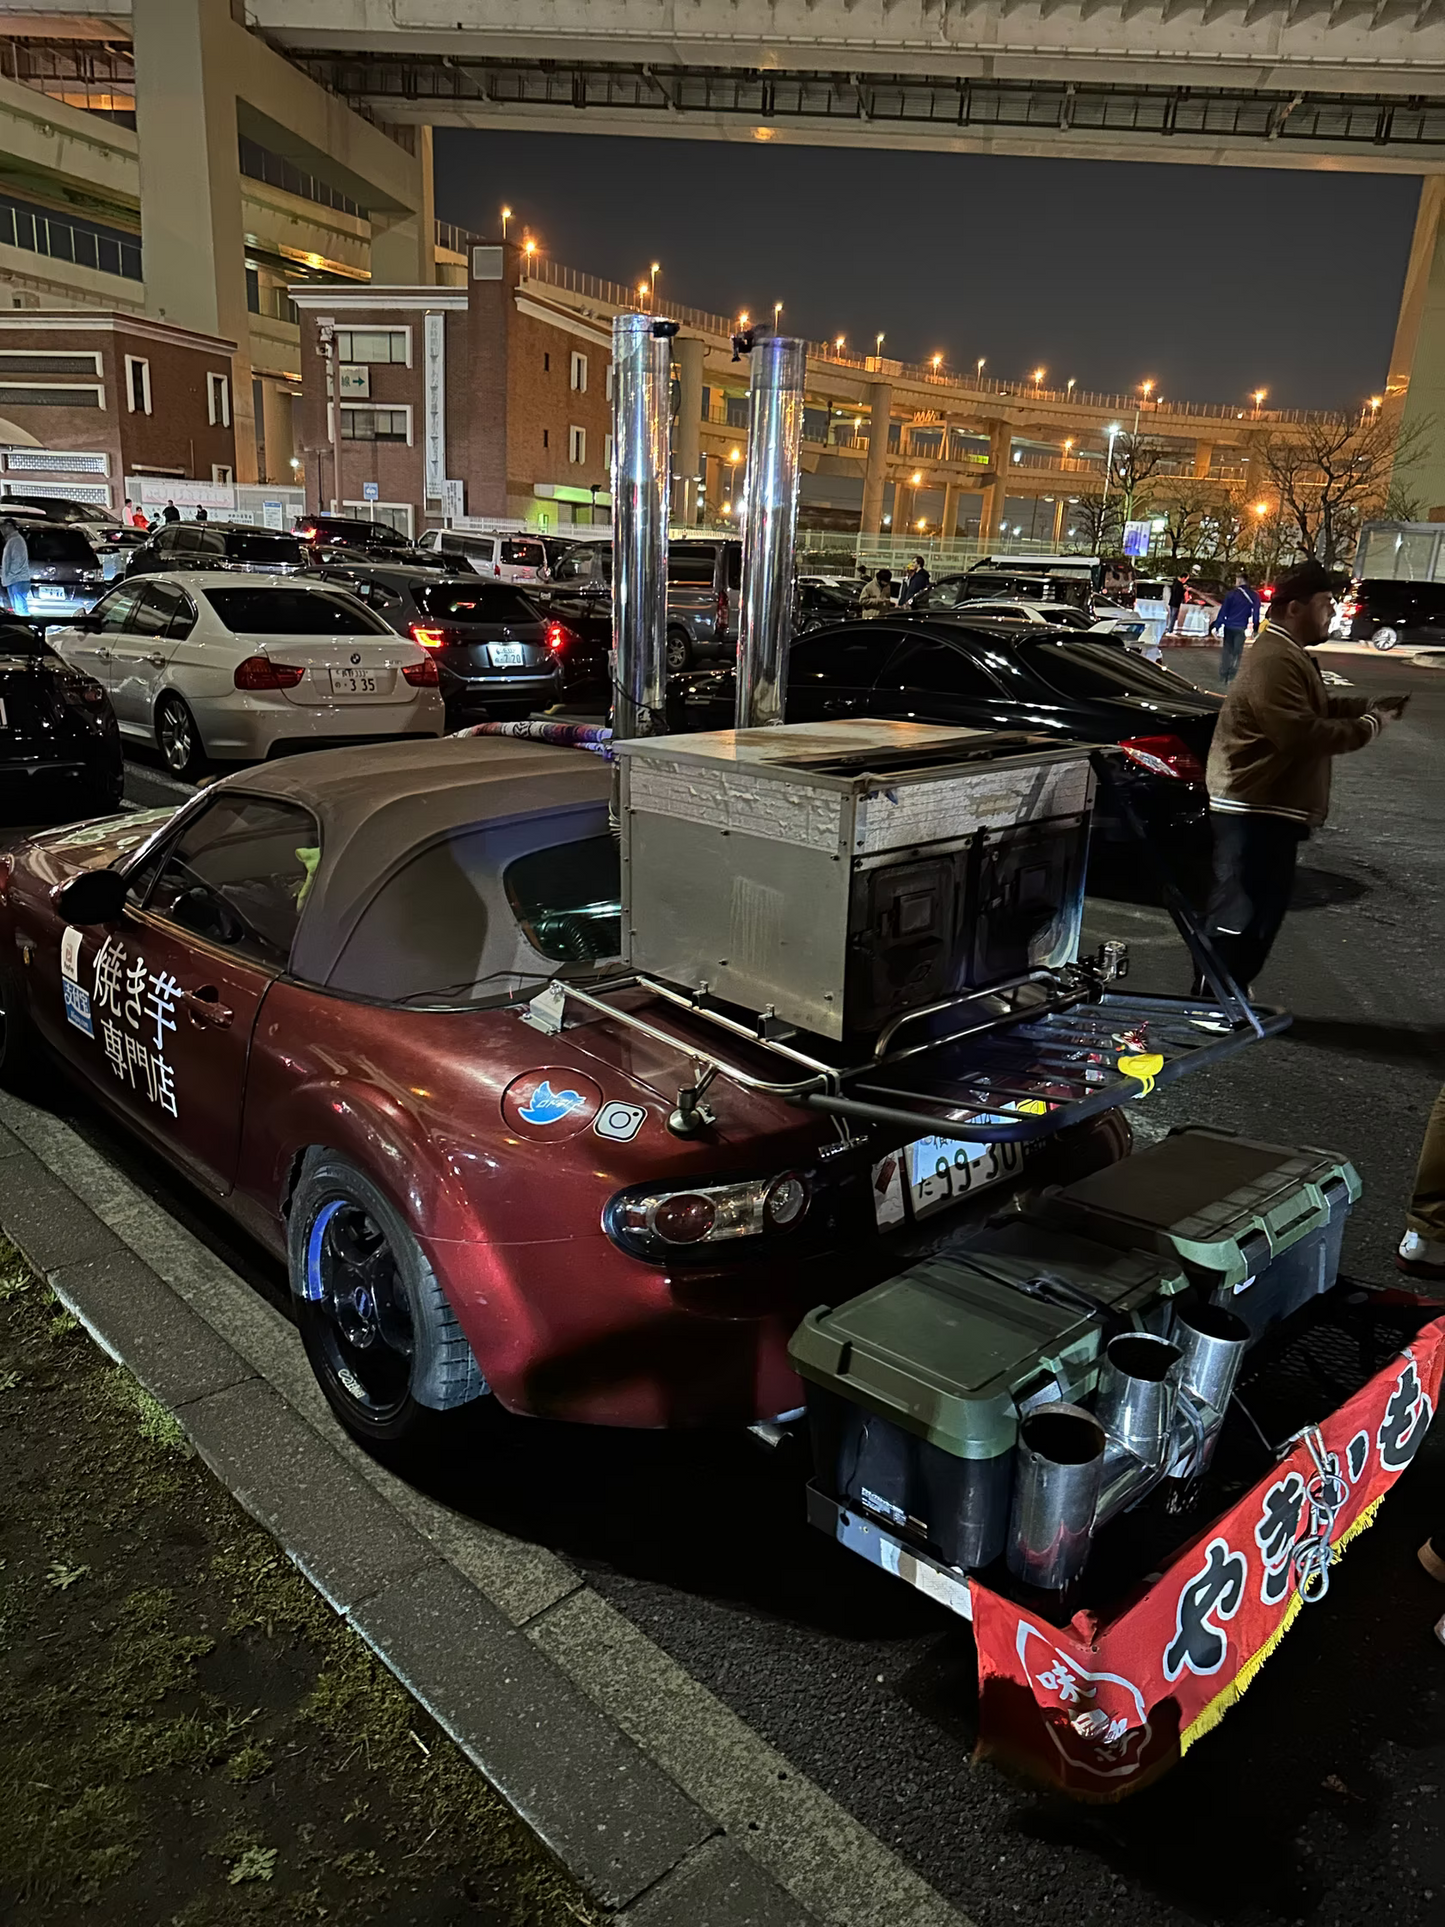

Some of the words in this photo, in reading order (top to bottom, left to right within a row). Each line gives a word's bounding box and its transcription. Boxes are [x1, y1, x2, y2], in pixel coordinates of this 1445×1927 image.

[93, 935, 182, 1050] 焼き芋
[100, 1018, 178, 1118] 専門店
[1163, 1361, 1434, 1682] やきいも
